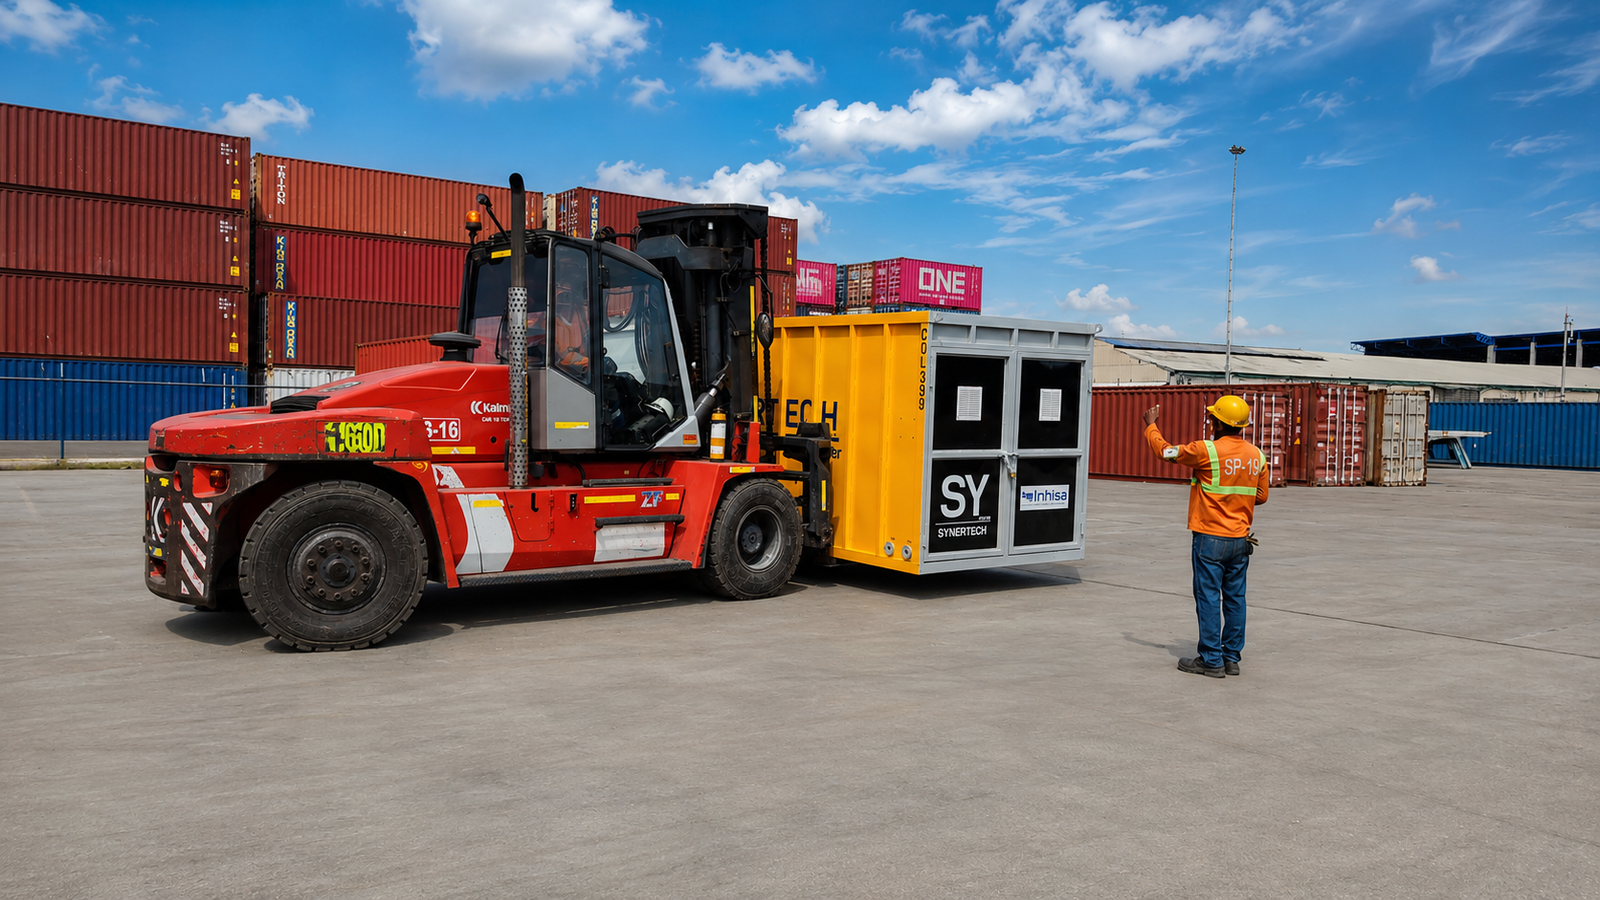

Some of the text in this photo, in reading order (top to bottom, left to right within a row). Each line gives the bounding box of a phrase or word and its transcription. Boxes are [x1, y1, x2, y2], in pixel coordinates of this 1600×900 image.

[277, 164, 286, 205] TRITON
[918, 267, 966, 295] ONE
[918, 327, 928, 411] COL399
[1224, 457, 1259, 476] SP-19
[940, 474, 990, 518] SY
[1034, 489, 1067, 502] Inhisa
[938, 525, 987, 538] SYNERTECH
